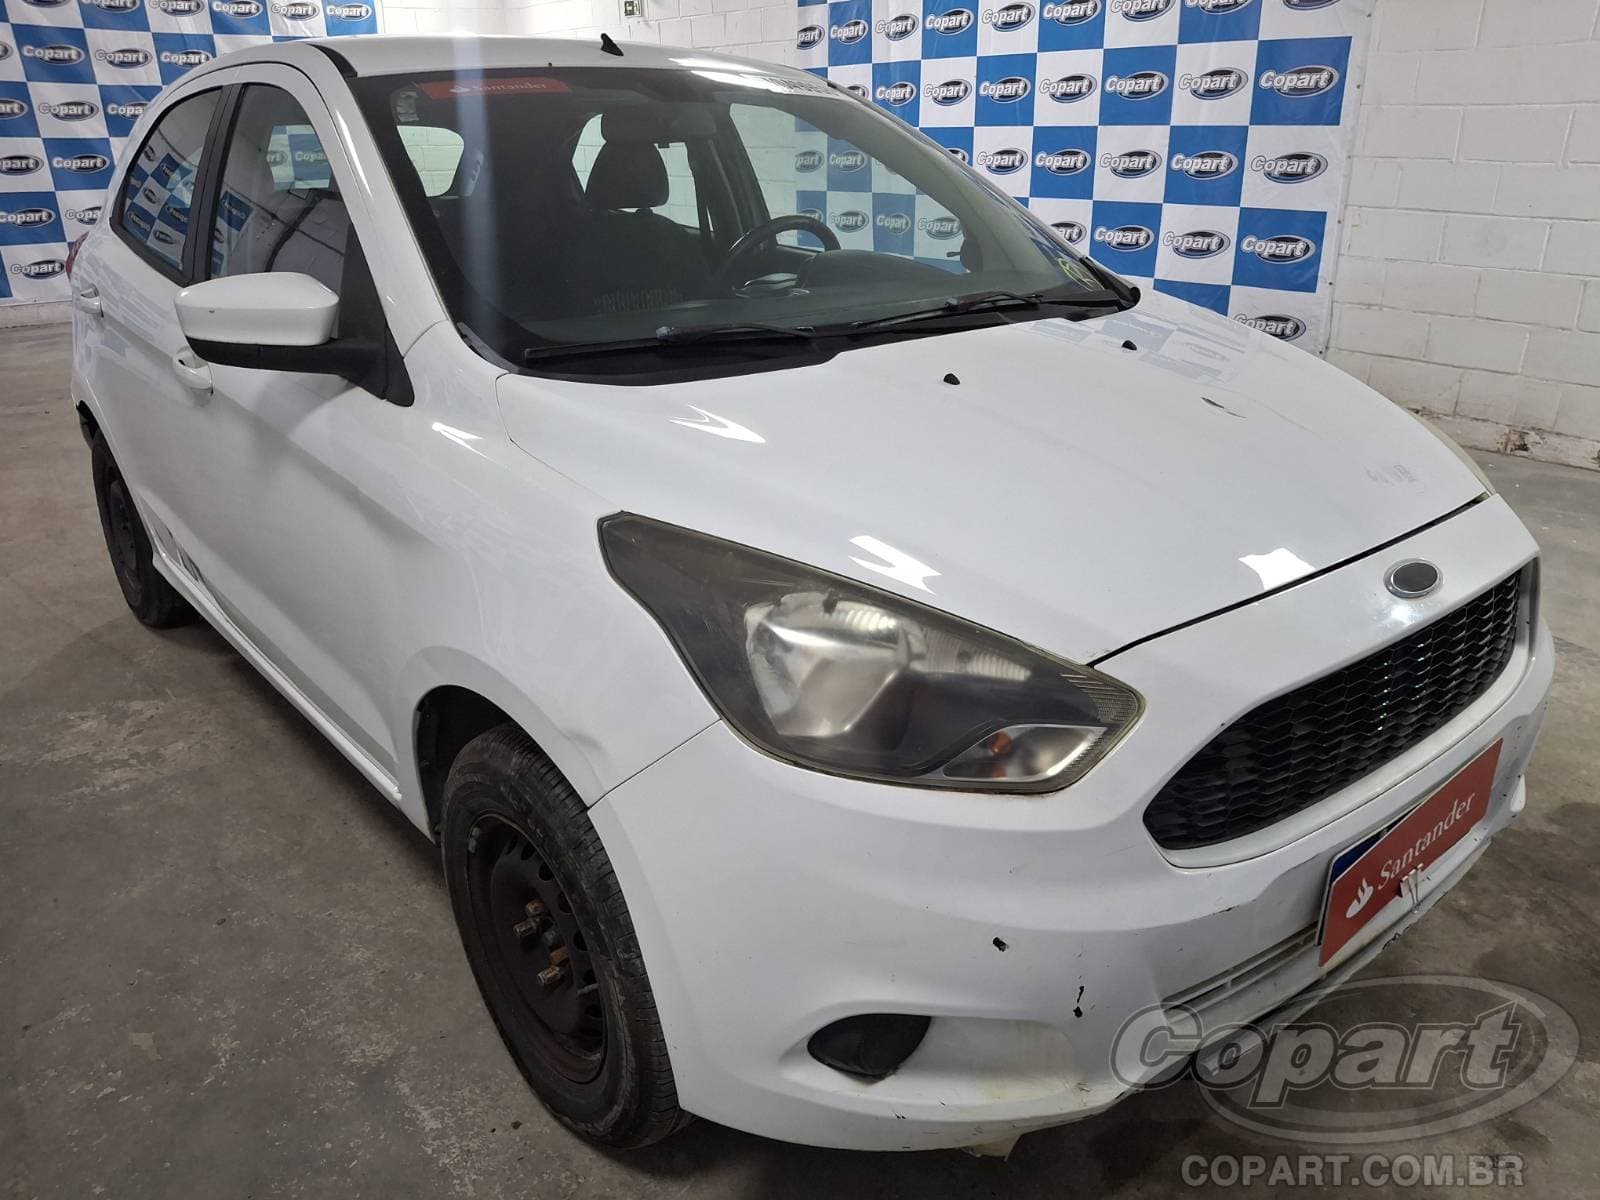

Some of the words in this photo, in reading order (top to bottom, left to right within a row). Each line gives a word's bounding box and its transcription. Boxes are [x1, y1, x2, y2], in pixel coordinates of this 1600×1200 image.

[212, 1, 257, 14] Copart
[271, 3, 314, 16] Copart
[327, 5, 369, 17] Copart
[1043, 2, 1094, 23] Copart
[926, 12, 969, 31] Copart
[982, 8, 1028, 28] Copart
[799, 29, 820, 44] part
[831, 25, 864, 42] Copart
[876, 18, 913, 39] Copart
[23, 45, 78, 63] Copart
[96, 50, 145, 65] Copart
[161, 51, 207, 65] Copart
[979, 80, 1026, 99] Copart
[1040, 77, 1090, 97] Copart
[1104, 74, 1161, 95] Copart
[1179, 72, 1239, 93] Copart
[1260, 69, 1330, 92] Copart
[876, 86, 911, 103] Copart
[923, 83, 967, 101] Copart
[39, 103, 91, 119] Copart
[107, 104, 144, 118] Copa
[0, 158, 36, 171] part
[53, 156, 103, 171] Copart
[829, 153, 863, 167] Copart
[977, 151, 1022, 169] Copart
[1035, 151, 1085, 169] Copart
[1100, 152, 1154, 173] Copart
[1171, 153, 1228, 174] Copart
[1251, 156, 1319, 177] Copart
[66, 208, 101, 224] Copa
[918, 217, 959, 234] Copart
[1094, 226, 1148, 246] Copart
[1163, 231, 1220, 253] Copart
[1241, 235, 1307, 257] Copart
[11, 262, 61, 278] Copart
[1377, 792, 1476, 891] Santander
